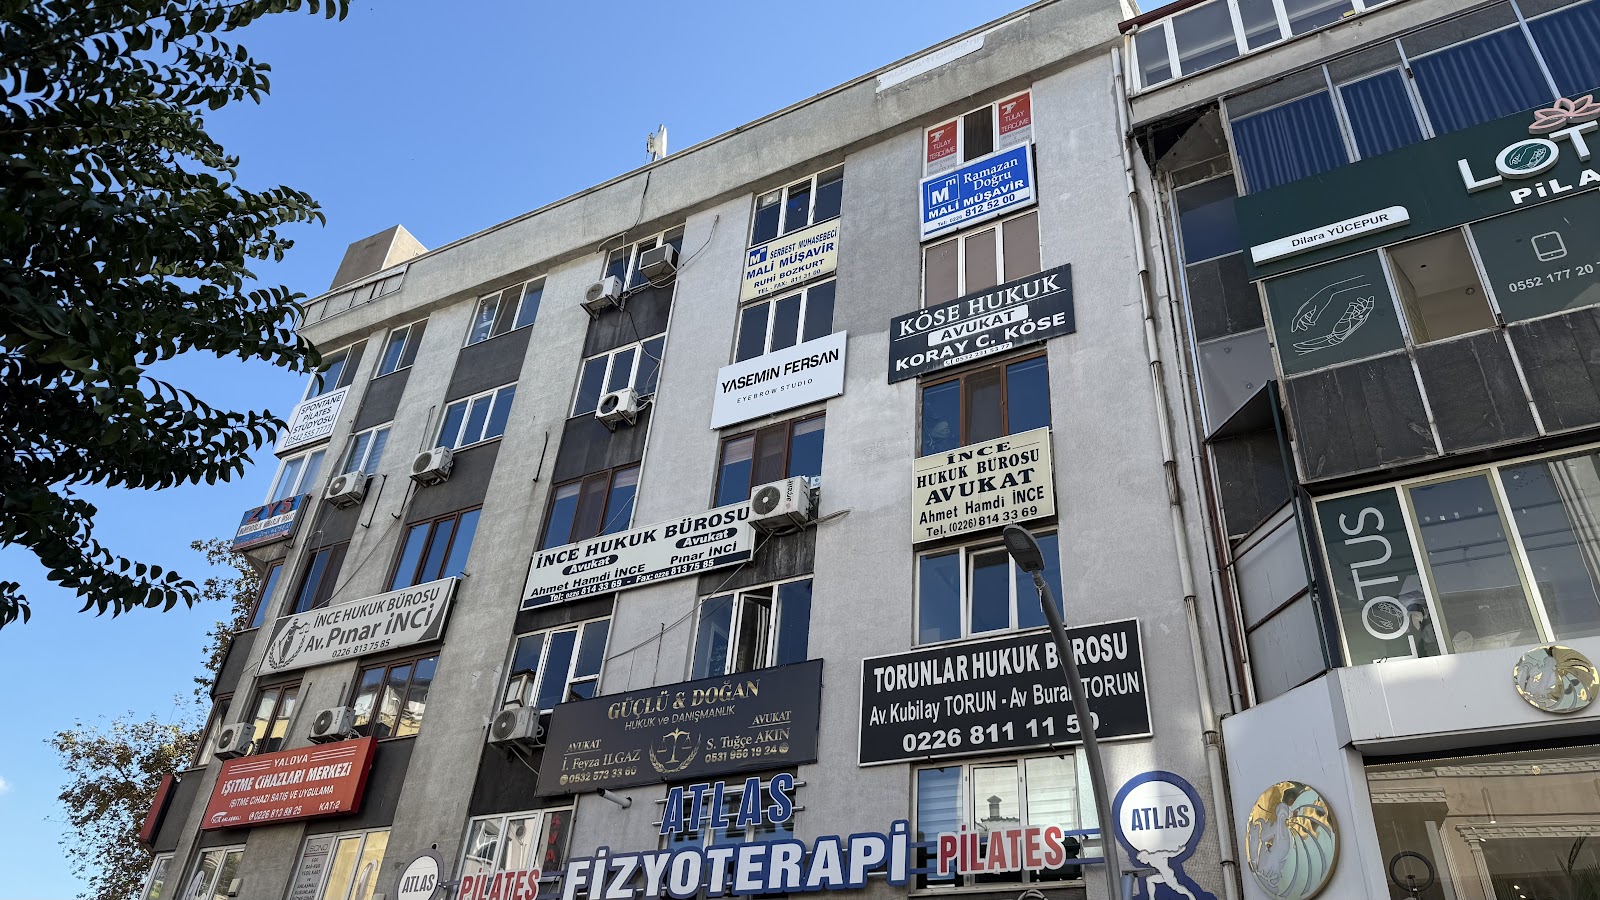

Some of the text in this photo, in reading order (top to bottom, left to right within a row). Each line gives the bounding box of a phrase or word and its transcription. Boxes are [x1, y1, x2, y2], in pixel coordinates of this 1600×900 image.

[1001, 118, 1029, 132] TERCÜME
[1004, 110, 1024, 122] TÜLAY
[929, 146, 956, 160] TERCÜME
[933, 138, 952, 150] TÜLAY
[963, 158, 1018, 184] Ramazan
[973, 170, 1012, 192] Doğru
[928, 179, 1024, 220] MALİ MÜŞAVİR
[965, 204, 984, 217] 812
[986, 198, 1000, 210] 52
[1002, 194, 1016, 204] 00
[770, 226, 838, 260] SERBEST MUHASEBECİ
[1291, 213, 1390, 248] Dilara YÜCEPUR
[746, 242, 834, 280] MALİ MÜŞAVİR
[754, 258, 824, 288] RUHİ BOZKURT
[1508, 264, 1594, 293] 0552 177 20
[899, 274, 1061, 337] KÖSE HUKUK
[940, 310, 1016, 342] AVUKAT
[895, 312, 1066, 372] KORAY C. KÖSE
[784, 348, 839, 376] FERSAN
[301, 394, 342, 414] SPONTANE
[736, 378, 813, 404] EYEBROW STUDIO
[292, 414, 334, 434] STÜDYOSU
[302, 406, 332, 422] PİLATES
[946, 440, 1011, 466] İNCE
[916, 448, 1040, 489] HUKUK BÜROSU
[925, 468, 1035, 506] AVUKAT
[920, 486, 1044, 525] Ahmet Hamdi İNCE
[926, 506, 1038, 537] Tel. (0226) 814 33 69
[536, 506, 750, 570] İNCE HUKUK BÜROSU
[568, 530, 729, 574] Avukat Avukat
[530, 540, 738, 598] Ahmet Hamdi İNCE Pınar İNCİ
[550, 593, 564, 602] Tel:
[580, 584, 597, 596] 814
[598, 582, 610, 592] 33
[611, 580, 622, 589] 69
[636, 574, 654, 584] Fax:
[670, 565, 688, 575] 813
[688, 562, 700, 571] 75
[702, 560, 714, 568] 85
[1338, 507, 1418, 664] LOTUS
[312, 587, 440, 629] İNCE HUKUK BÜROSU
[304, 634, 324, 653] Av.
[326, 622, 381, 648] Pınar
[332, 638, 391, 658] 0226 813 75 85
[874, 631, 1128, 694] TORUNLAR HUKUK BROSU
[607, 679, 760, 720] GÜÇLÜ & DOĞAN
[870, 706, 888, 726] Av.
[890, 700, 940, 724] Kubilay
[944, 690, 997, 717] TORUN
[1010, 687, 1028, 708] Av
[1081, 671, 1140, 699] TORUN
[624, 704, 736, 731] HUKUK ve DANIŞMANLIK
[752, 710, 792, 725] AVUKAT
[566, 738, 602, 752] AVUKAT
[706, 728, 790, 750] S. Tuğçe AKIN
[902, 728, 962, 752] 0226
[970, 721, 1014, 745] 811
[1026, 716, 1055, 738] 11
[273, 754, 308, 768] YALOVA
[572, 754, 600, 772] Feyza
[602, 749, 641, 766] ILGAZ
[705, 745, 778, 764] 0531 956 19 24
[568, 772, 591, 784] 0532
[592, 768, 610, 780] 573
[610, 767, 624, 778] 33
[290, 790, 298, 799] VE
[298, 784, 334, 798] UYGULAMA
[659, 773, 795, 835] ATLAS
[293, 806, 302, 815] 25
[318, 800, 340, 811] KAT:2
[1130, 804, 1190, 832] ATLAS
[562, 822, 908, 900] FİZYOTERAPİ
[940, 824, 1064, 873] PİLATES
[402, 874, 436, 894] ATLAS
